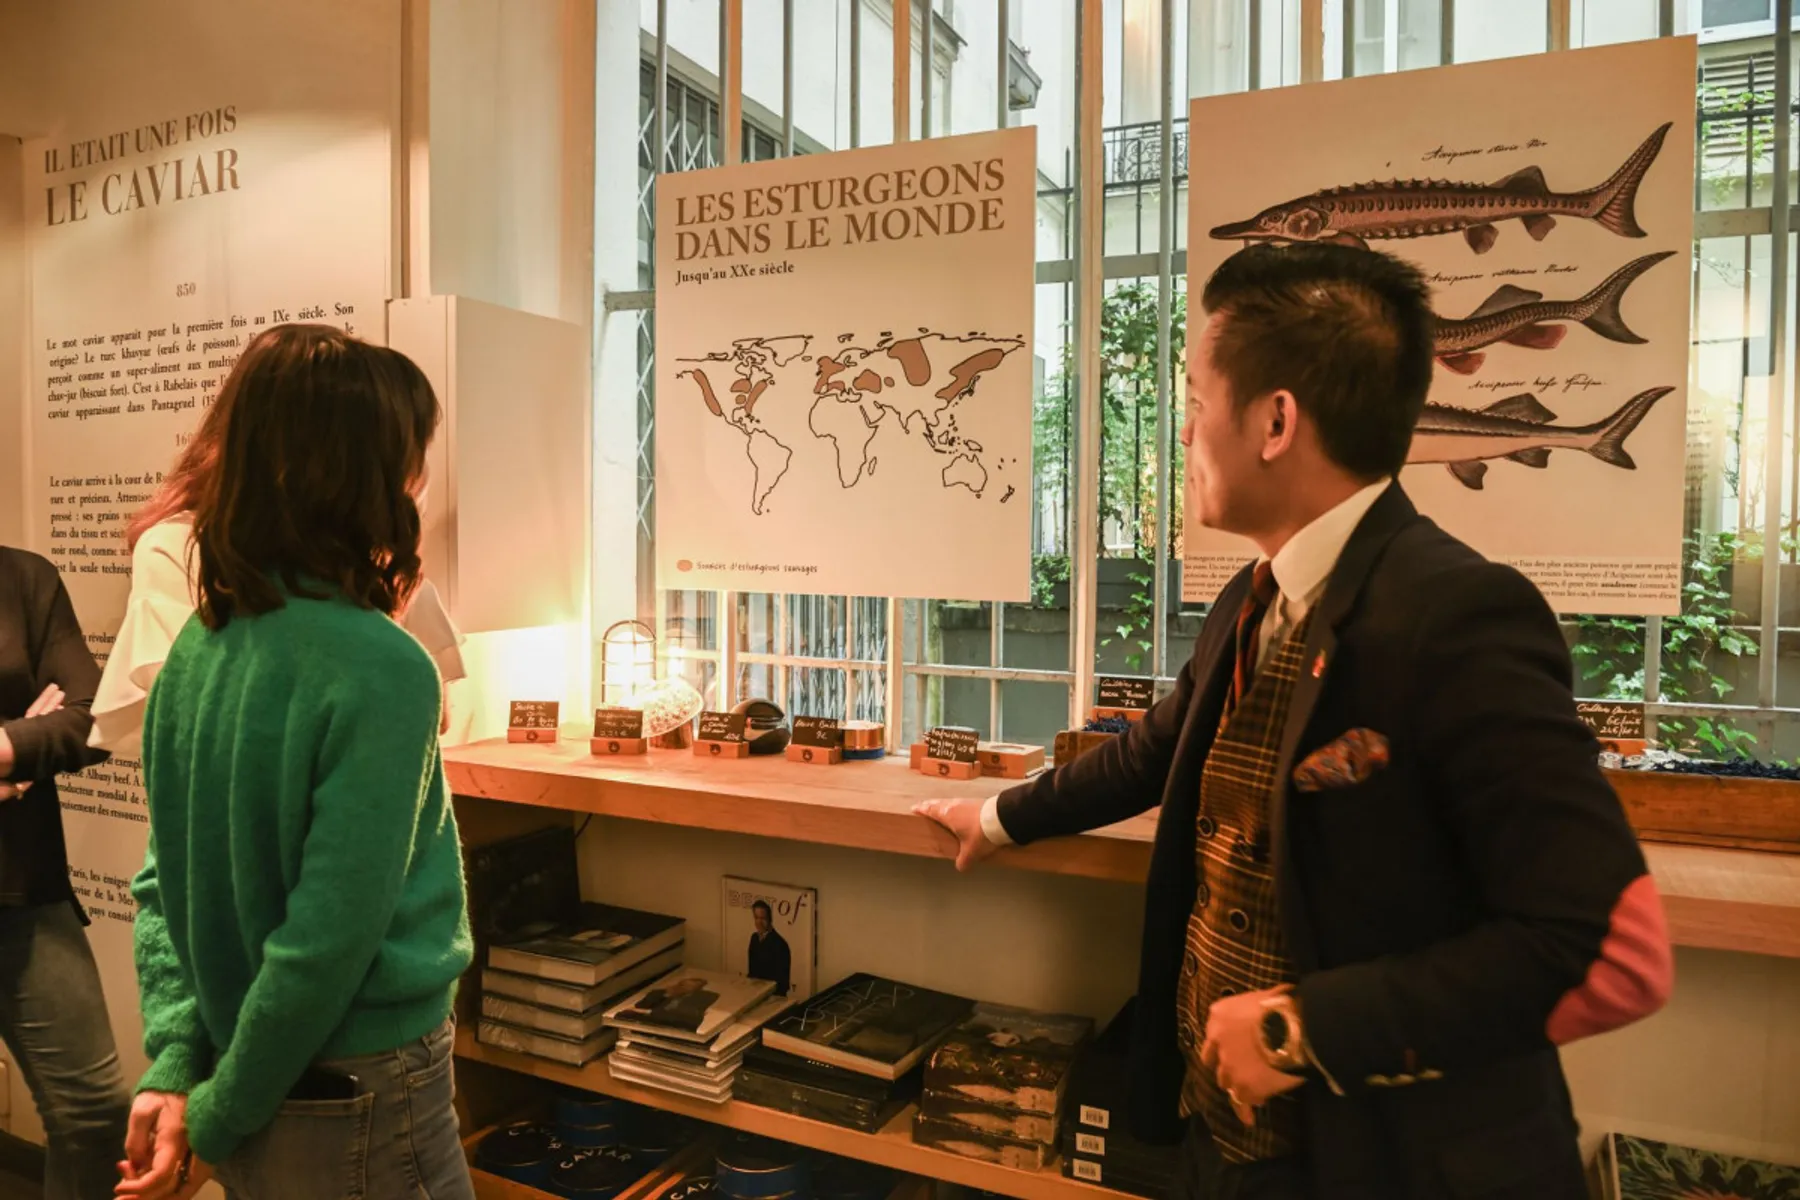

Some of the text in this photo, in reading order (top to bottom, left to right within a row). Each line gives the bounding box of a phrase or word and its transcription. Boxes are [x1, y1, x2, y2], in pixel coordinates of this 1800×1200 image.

[45, 105, 237, 174] IL ETAIT UNE FOIS
[46, 148, 240, 226] LE CAVIAR
[675, 158, 1006, 226] LES ESTURGEONS
[675, 197, 1006, 262] DANS LE MONDE
[676, 260, 795, 286] Jusqu'au XXe siècle
[176, 282, 196, 297] 850
[46, 339, 56, 350] Le
[62, 339, 77, 348] mot
[82, 335, 105, 346] caviar
[148, 327, 166, 342] pour
[172, 323, 180, 334] la
[187, 318, 223, 337] première
[230, 315, 247, 328] fois
[254, 316, 266, 326] au
[273, 309, 290, 323] IXe
[298, 306, 327, 320] siècle.
[334, 302, 354, 316] Son
[84, 352, 95, 364] Le
[186, 340, 196, 352] de
[203, 336, 241, 354] poisson).
[78, 371, 104, 382] comme
[110, 370, 121, 378] un
[127, 362, 180, 380] super-aliment
[188, 361, 202, 370] aux
[208, 354, 240, 370] multipl
[80, 386, 107, 399] (biscuit
[132, 382, 151, 394] C'est
[155, 382, 160, 392] à
[164, 378, 197, 392] Rabelais
[201, 378, 216, 392] que
[48, 409, 69, 419] caviar
[127, 400, 145, 413] dans
[152, 397, 195, 413] Pantagruel
[50, 476, 60, 487] Le
[62, 477, 83, 486] caviar
[108, 476, 112, 485] à
[116, 474, 122, 485] la
[124, 476, 142, 484] cour
[144, 472, 153, 484] de
[68, 494, 76, 504] et
[82, 512, 93, 520] ses
[98, 510, 120, 525] grains
[51, 527, 67, 538] dans
[69, 527, 79, 538] du
[100, 529, 108, 538] et
[51, 544, 117, 557] noir rond, comme
[69, 562, 76, 572] la
[80, 562, 98, 573] seule
[102, 562, 132, 578] techniq
[730, 562, 780, 575] d'esturgeons
[784, 564, 818, 576] sauvages
[116, 758, 143, 772] exempl
[86, 768, 112, 786] Albany
[114, 772, 132, 786] beef.
[56, 782, 94, 796] roducteur
[98, 789, 128, 802] mondial
[131, 792, 140, 805] de
[98, 804, 110, 815] des
[110, 809, 148, 823] ressources
[90, 868, 100, 882] les
[95, 887, 134, 906] de la Mer
[88, 906, 104, 919] pays
[778, 893, 807, 926] of
[508, 1127, 562, 1150] CAVIAR
[560, 1148, 632, 1169] CAVIAR
